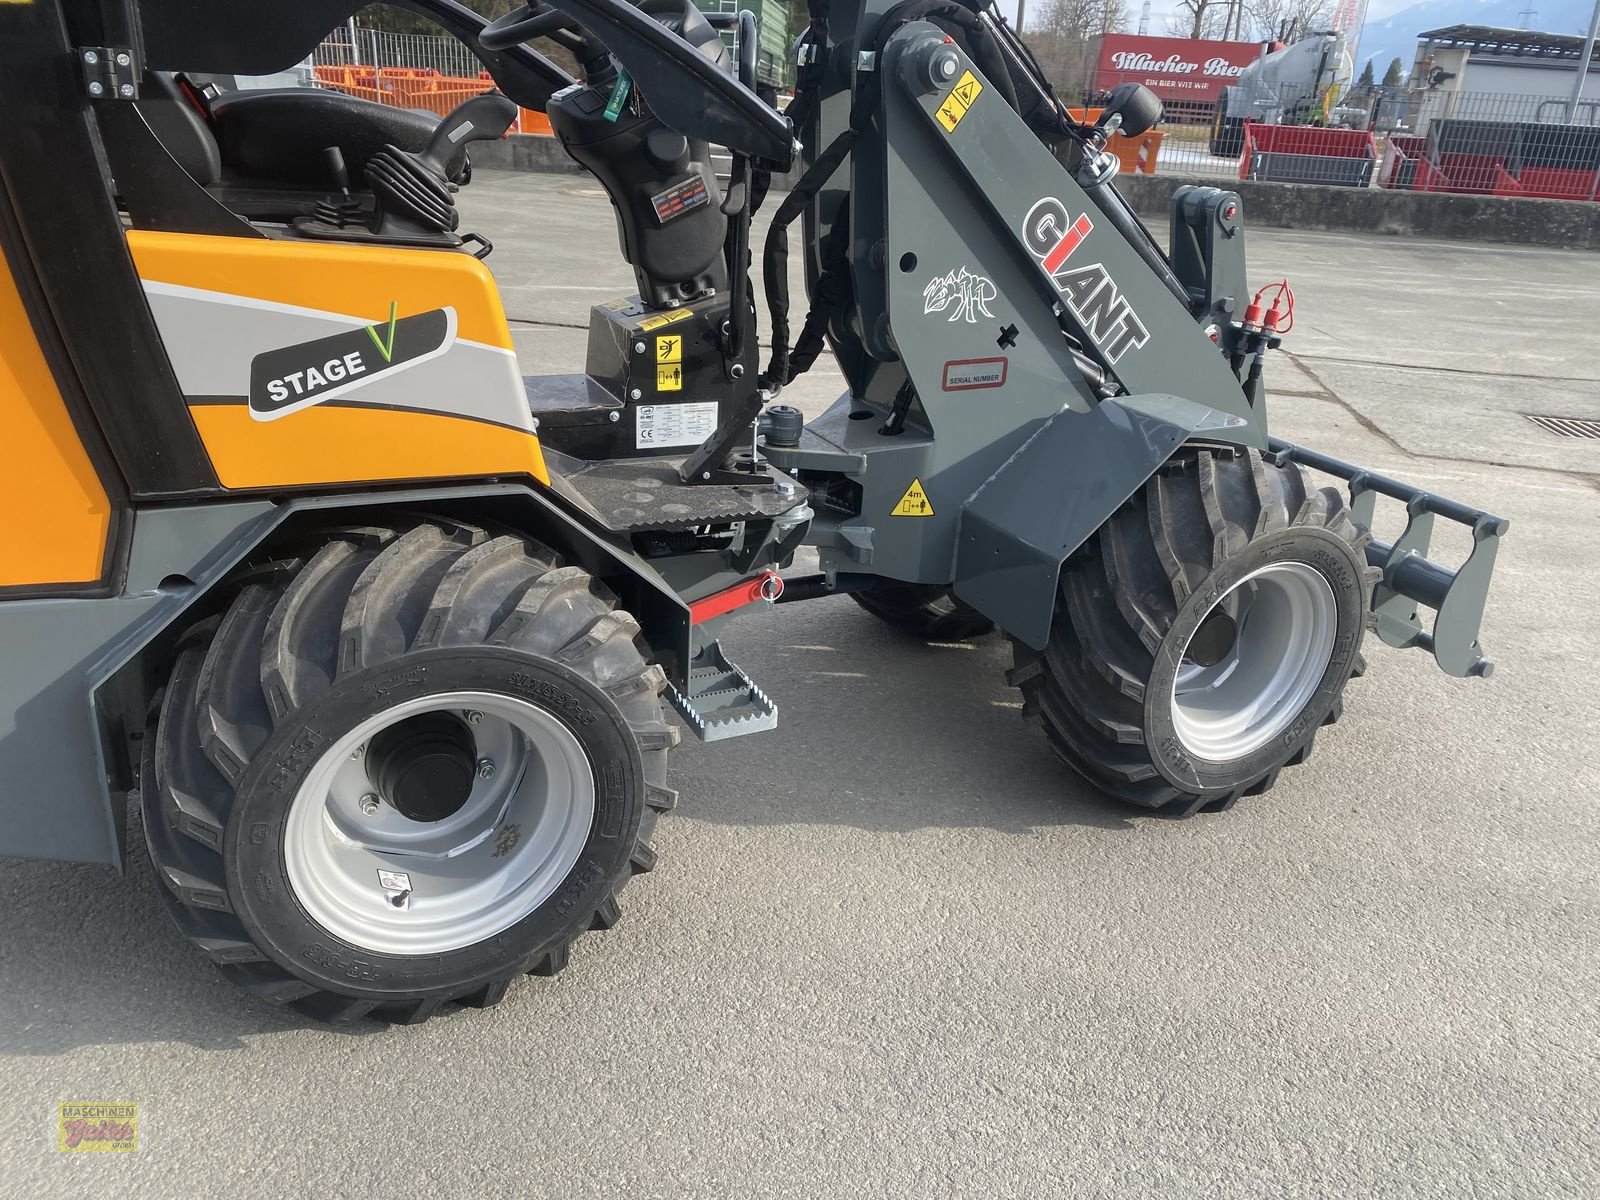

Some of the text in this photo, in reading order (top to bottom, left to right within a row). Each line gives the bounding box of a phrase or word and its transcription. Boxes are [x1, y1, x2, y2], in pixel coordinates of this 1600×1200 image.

[1111, 52, 1247, 77] Villacher Bier
[1178, 81, 1193, 89] WIE
[267, 300, 397, 402] STAGE V
[950, 374, 999, 385] SERIAL NUMBER
[907, 490, 922, 498] 4m
